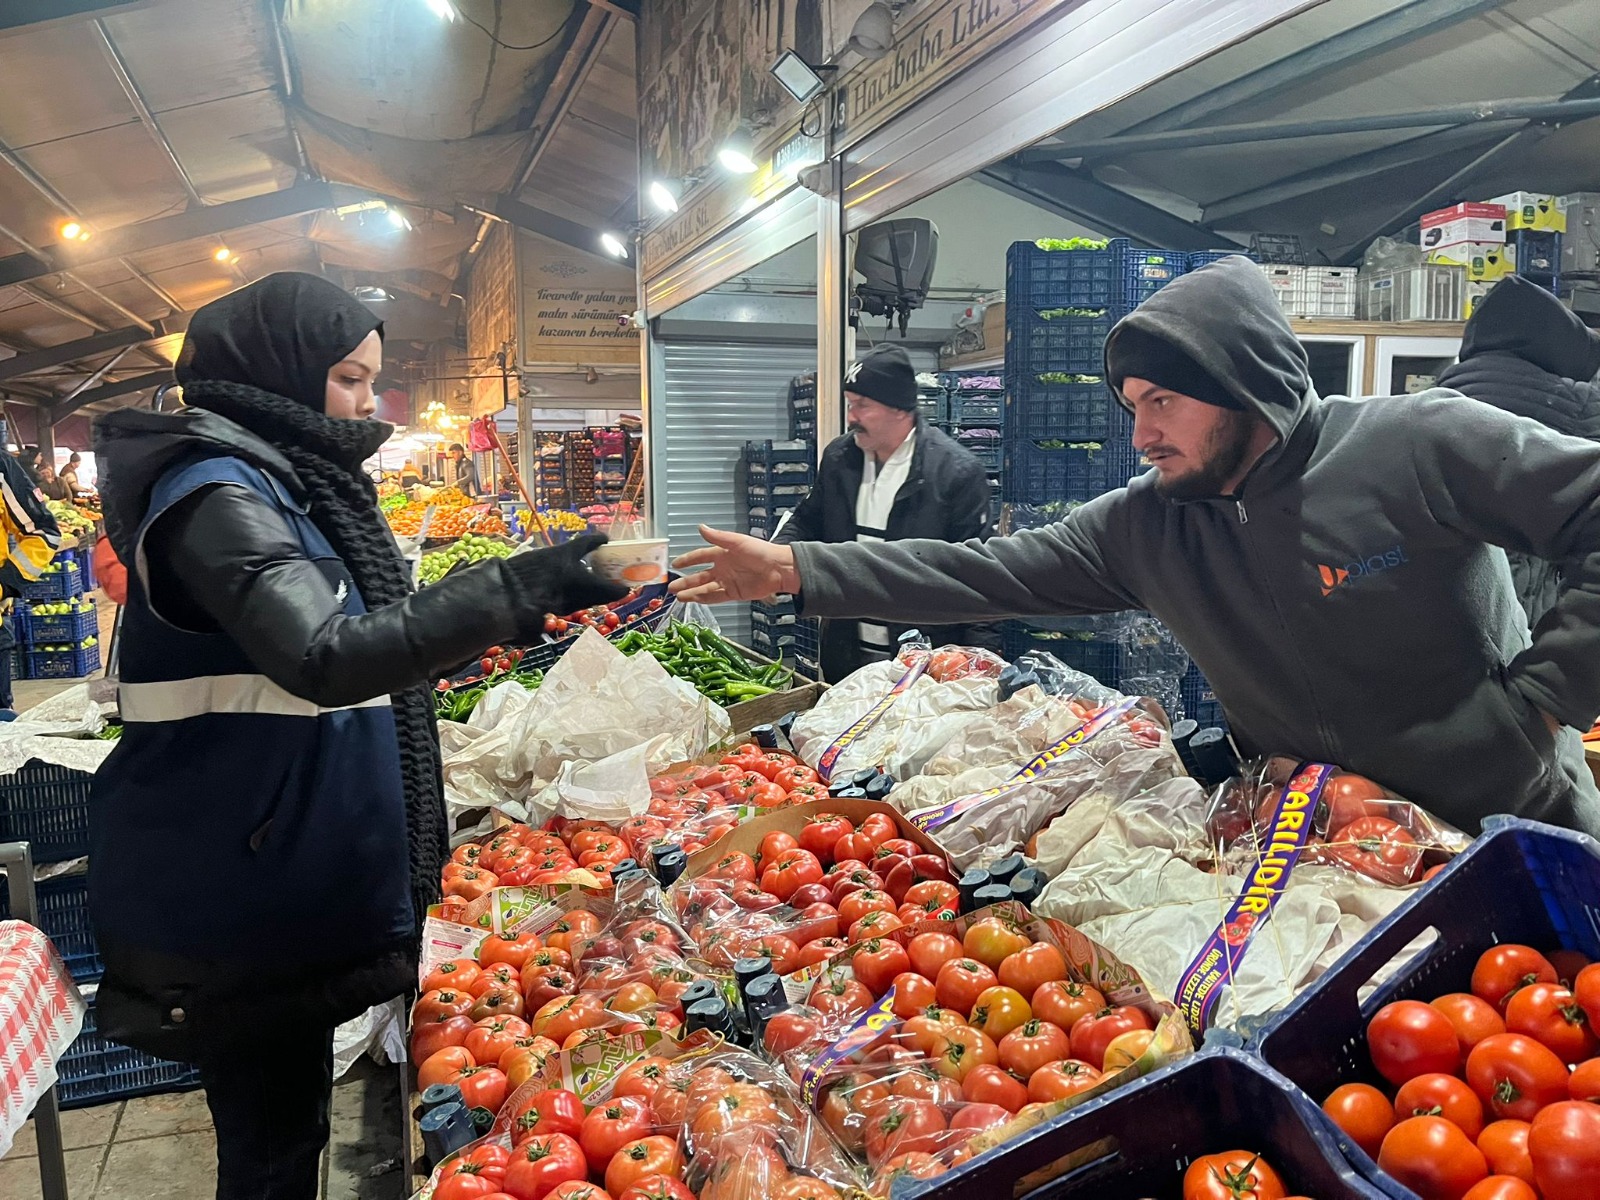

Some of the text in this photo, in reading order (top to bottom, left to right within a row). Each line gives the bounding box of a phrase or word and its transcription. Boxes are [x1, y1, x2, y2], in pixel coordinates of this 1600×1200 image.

[951, 0, 999, 50] Ltd.
[537, 288, 583, 301] Ticarette
[585, 291, 616, 304] yalan
[537, 308, 568, 319] malın
